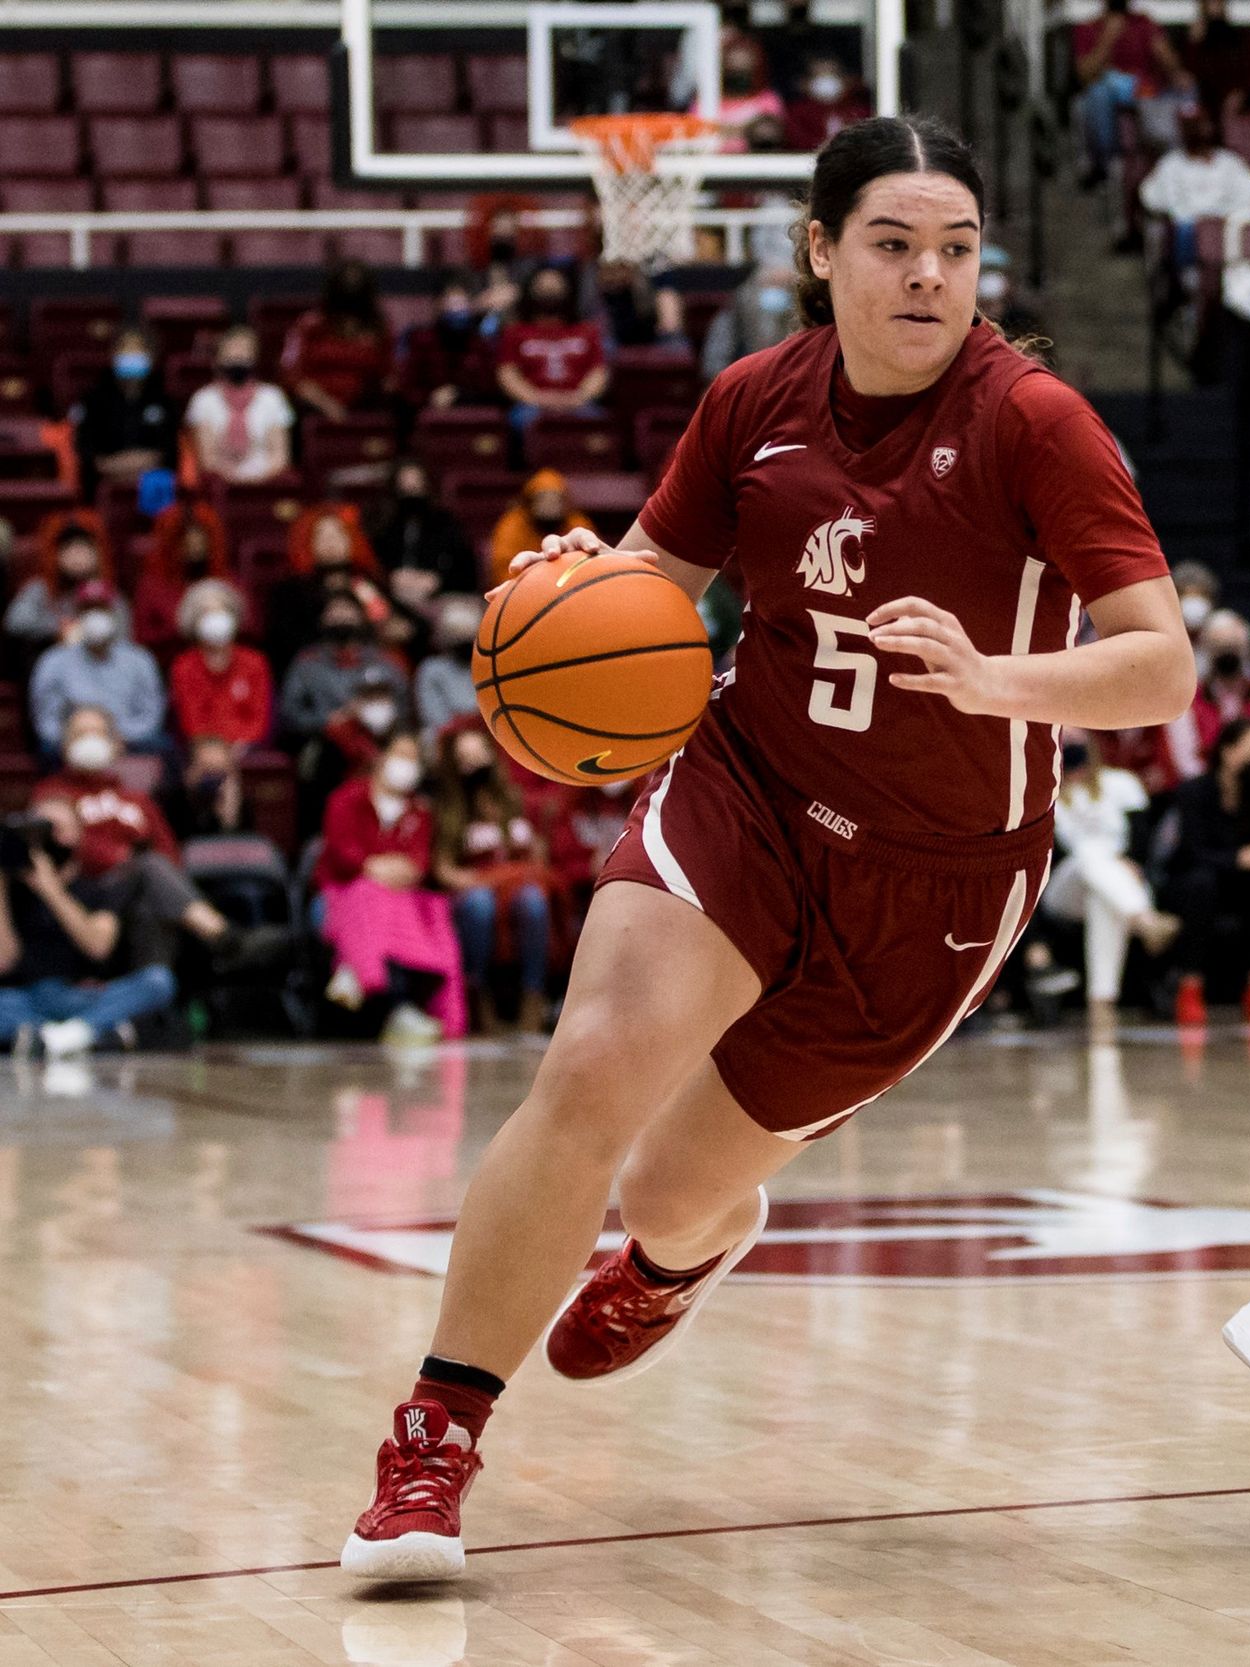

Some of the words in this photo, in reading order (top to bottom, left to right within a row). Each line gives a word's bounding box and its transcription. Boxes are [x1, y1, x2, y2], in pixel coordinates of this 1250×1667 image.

[935, 460, 948, 471] 12
[805, 608, 878, 732] 5
[806, 800, 859, 840] COUGS
